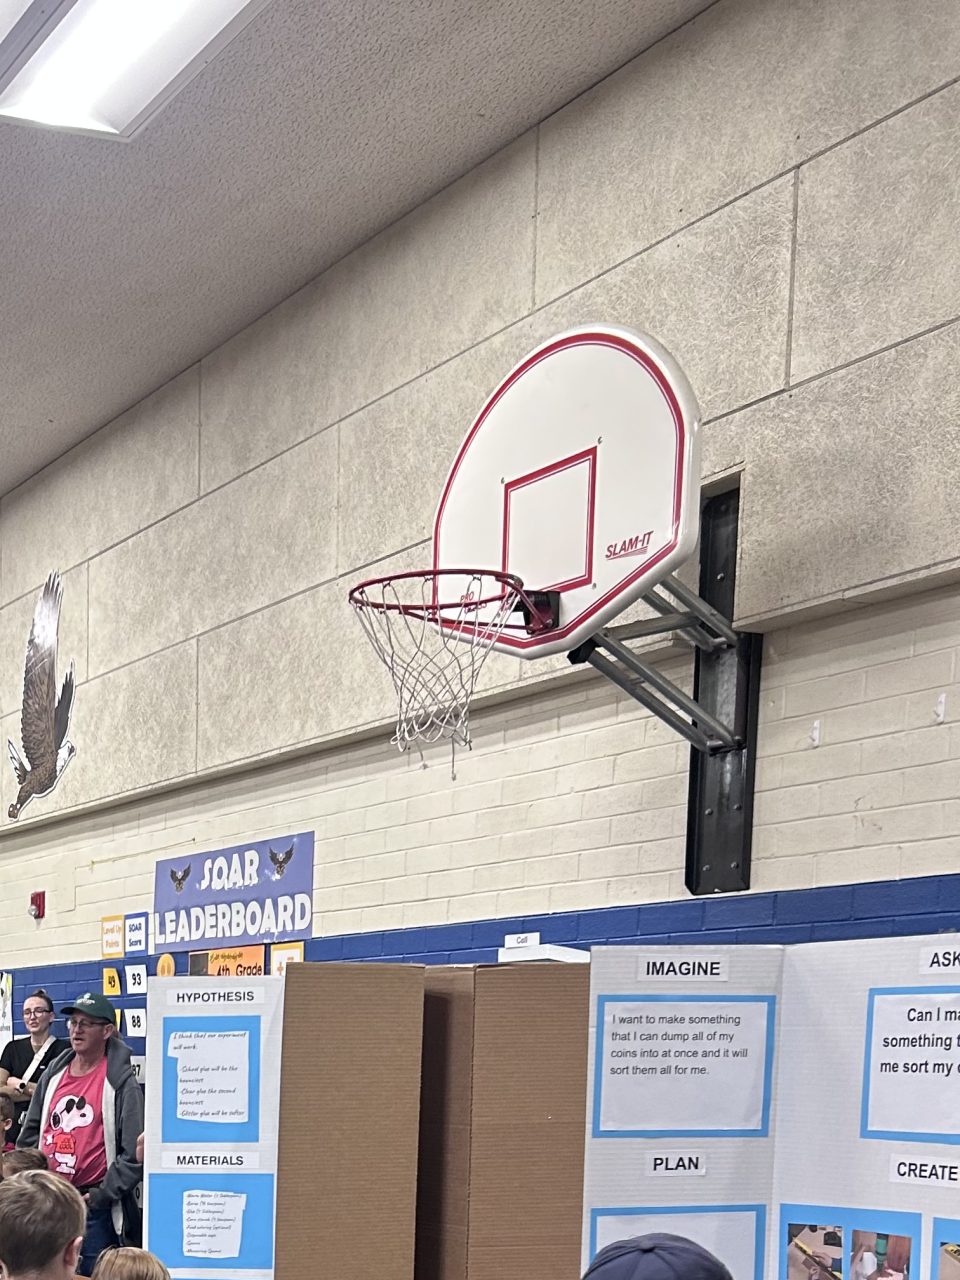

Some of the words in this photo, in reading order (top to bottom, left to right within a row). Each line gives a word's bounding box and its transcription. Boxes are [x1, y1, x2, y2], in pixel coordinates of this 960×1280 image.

[605, 530, 654, 558] SLAM-IT
[200, 849, 260, 891] SOAR
[154, 893, 312, 945] LEADERBOARD
[128, 922, 142, 933] SOAR
[128, 938, 142, 947] Score
[235, 962, 262, 976] Grade
[646, 961, 721, 976] IMAGINE
[108, 975, 116, 988] 49
[131, 972, 142, 986] 93
[176, 991, 255, 1003] HYPOTHESIS
[131, 1015, 141, 1028] 88
[618, 1015, 643, 1024] want
[645, 1015, 655, 1024] to
[658, 1014, 686, 1024] make
[688, 1014, 741, 1026] something
[907, 1008, 933, 1022] Can
[936, 1007, 940, 1021] I
[611, 1032, 630, 1041] that
[639, 1033, 658, 1041] can
[661, 1032, 689, 1043] dump
[692, 1032, 703, 1041] all
[706, 1031, 718, 1041] of
[719, 1033, 734, 1043] my
[882, 1033, 953, 1051] something
[611, 1048, 637, 1058] coins
[640, 1048, 659, 1058] into
[661, 1049, 672, 1058] at
[674, 1050, 698, 1058] once
[701, 1048, 720, 1058] and
[723, 1048, 729, 1058] it
[732, 1048, 748, 1058] will
[610, 1066, 629, 1075] sort
[631, 1065, 657, 1075] them
[660, 1065, 672, 1075] all
[674, 1065, 687, 1075] for
[690, 1067, 710, 1075] me.
[880, 1062, 899, 1073] me
[902, 1060, 929, 1073] sort
[932, 1062, 954, 1077] my
[176, 1155, 244, 1166] MATERIALS
[653, 1156, 700, 1171] PLAN
[897, 1161, 959, 1182] CREATE
